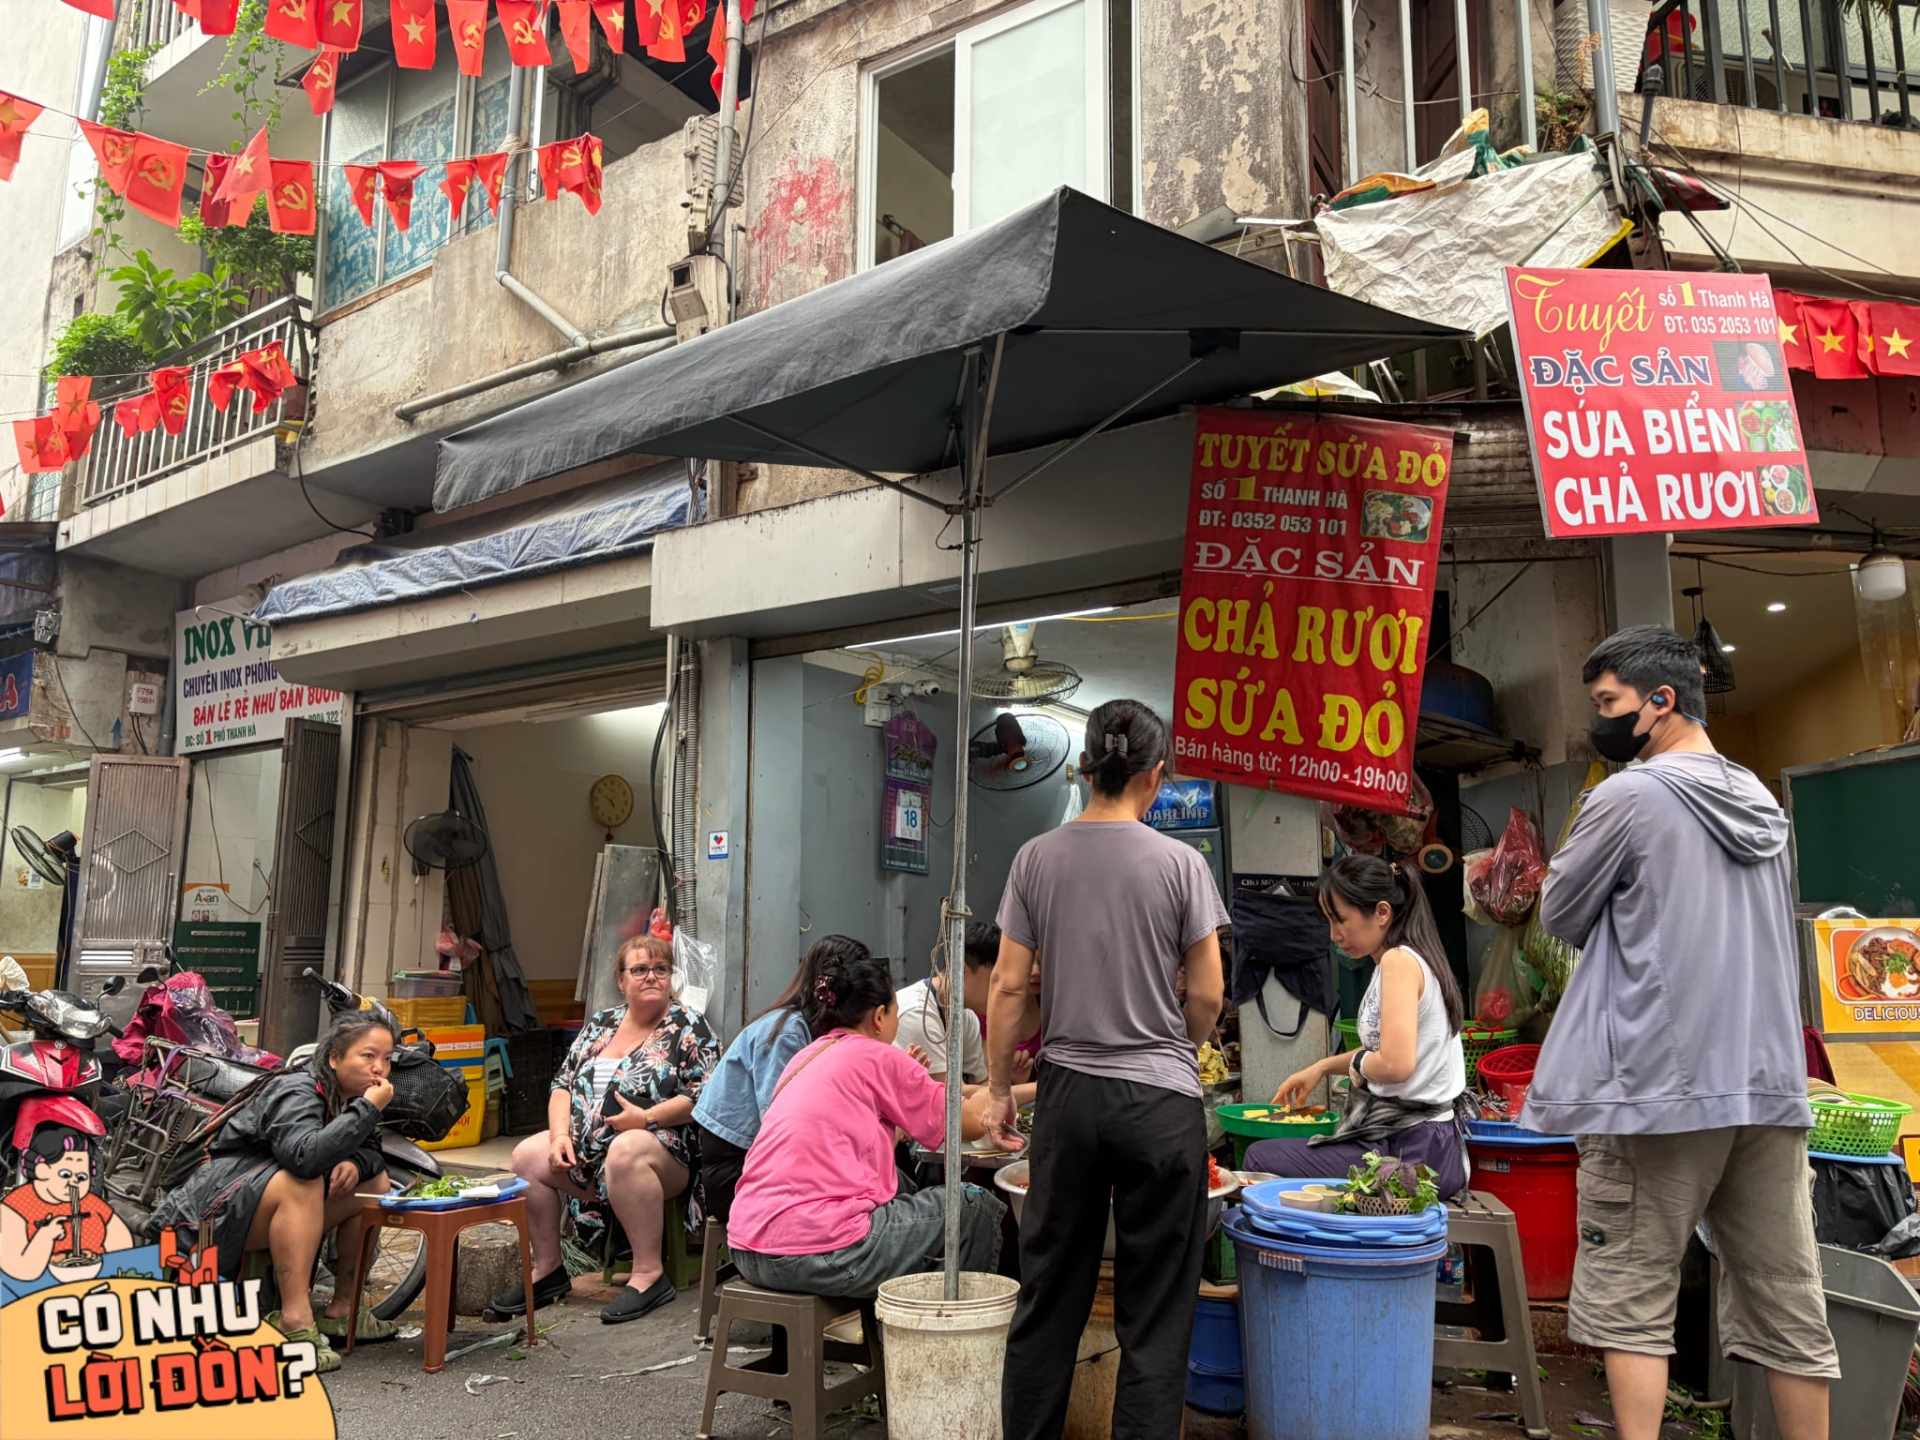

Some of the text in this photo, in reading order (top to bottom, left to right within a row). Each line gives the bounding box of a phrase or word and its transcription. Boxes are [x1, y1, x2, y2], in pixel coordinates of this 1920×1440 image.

[1514, 274, 1655, 352] Tuyết
[1658, 280, 1770, 309] số 1 Thanh Hà
[1664, 316, 1776, 335] ĐT: 035 2053 101
[1529, 347, 1712, 394] ĐẶC SẢN
[1543, 391, 1741, 459] SỨA BIỂN
[1199, 422, 1447, 487] TUYẾT SỨA ĐỎ
[1201, 476, 1348, 510] SỐ 1 THANH HÀ
[1554, 461, 1760, 526] CHẢ RƯƠI
[1199, 509, 1347, 536] ĐT: 0352 053 101
[1193, 537, 1424, 587] ĐẶC SẢN
[184, 612, 272, 666] INOX VI
[1184, 580, 1424, 674] CHẢ RƯƠI
[183, 671, 218, 698] CHUYÊN
[220, 667, 242, 688] INOX
[193, 700, 215, 727] BÁN
[218, 693, 231, 722] LẺ
[234, 690, 249, 720] RẺ
[252, 686, 278, 716] NHƯ
[279, 683, 304, 711] BÁN
[1185, 666, 1404, 758] SỨA ĐỎ
[205, 729, 212, 745] 1
[227, 726, 246, 740] THANH
[247, 721, 256, 737] HÀ
[1175, 736, 1207, 760] Bán
[1212, 741, 1253, 772] hàng
[904, 809, 917, 828] 18
[1143, 806, 1208, 823] DARLING
[1853, 1006, 1920, 1021] DELICIOU
